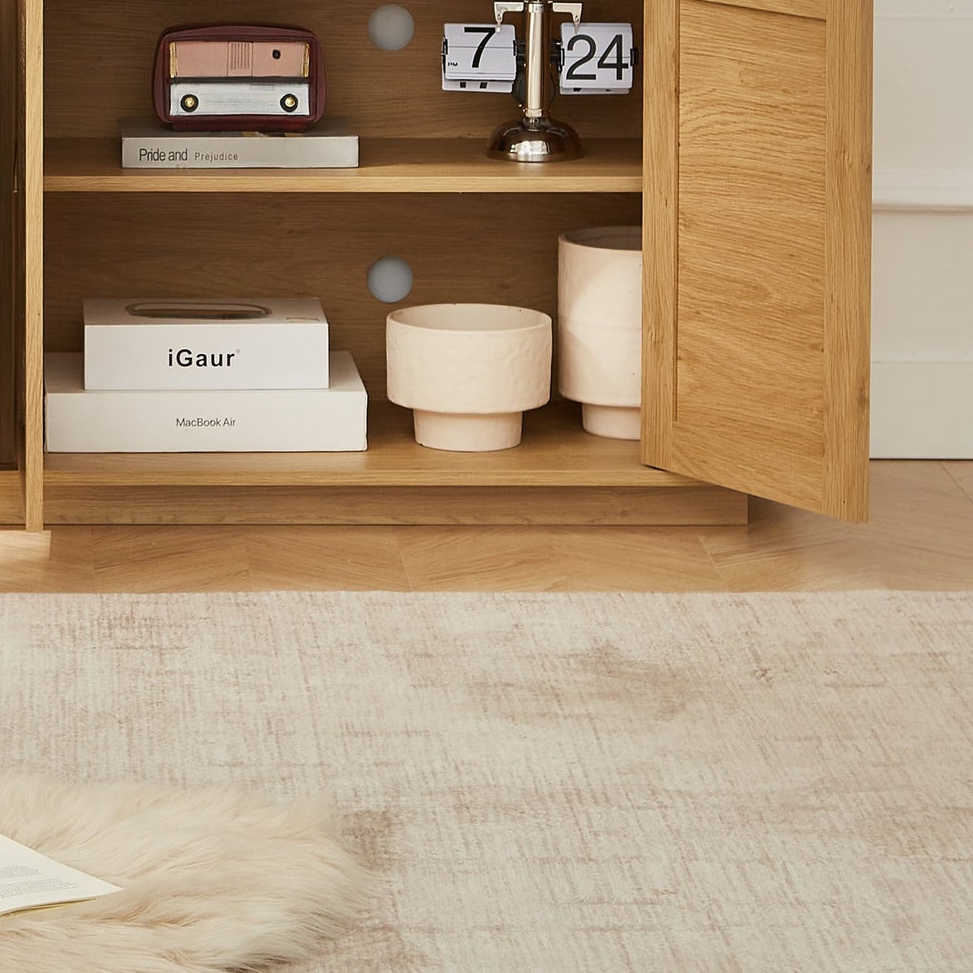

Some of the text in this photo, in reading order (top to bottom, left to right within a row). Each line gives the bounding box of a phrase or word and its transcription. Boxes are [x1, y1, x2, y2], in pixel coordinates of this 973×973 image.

[464, 27, 496, 68] 7
[566, 34, 629, 80] 24
[139, 148, 239, 163] Pride and Prejudice
[168, 348, 236, 368] iGaur
[176, 417, 236, 427] MacBook Air
